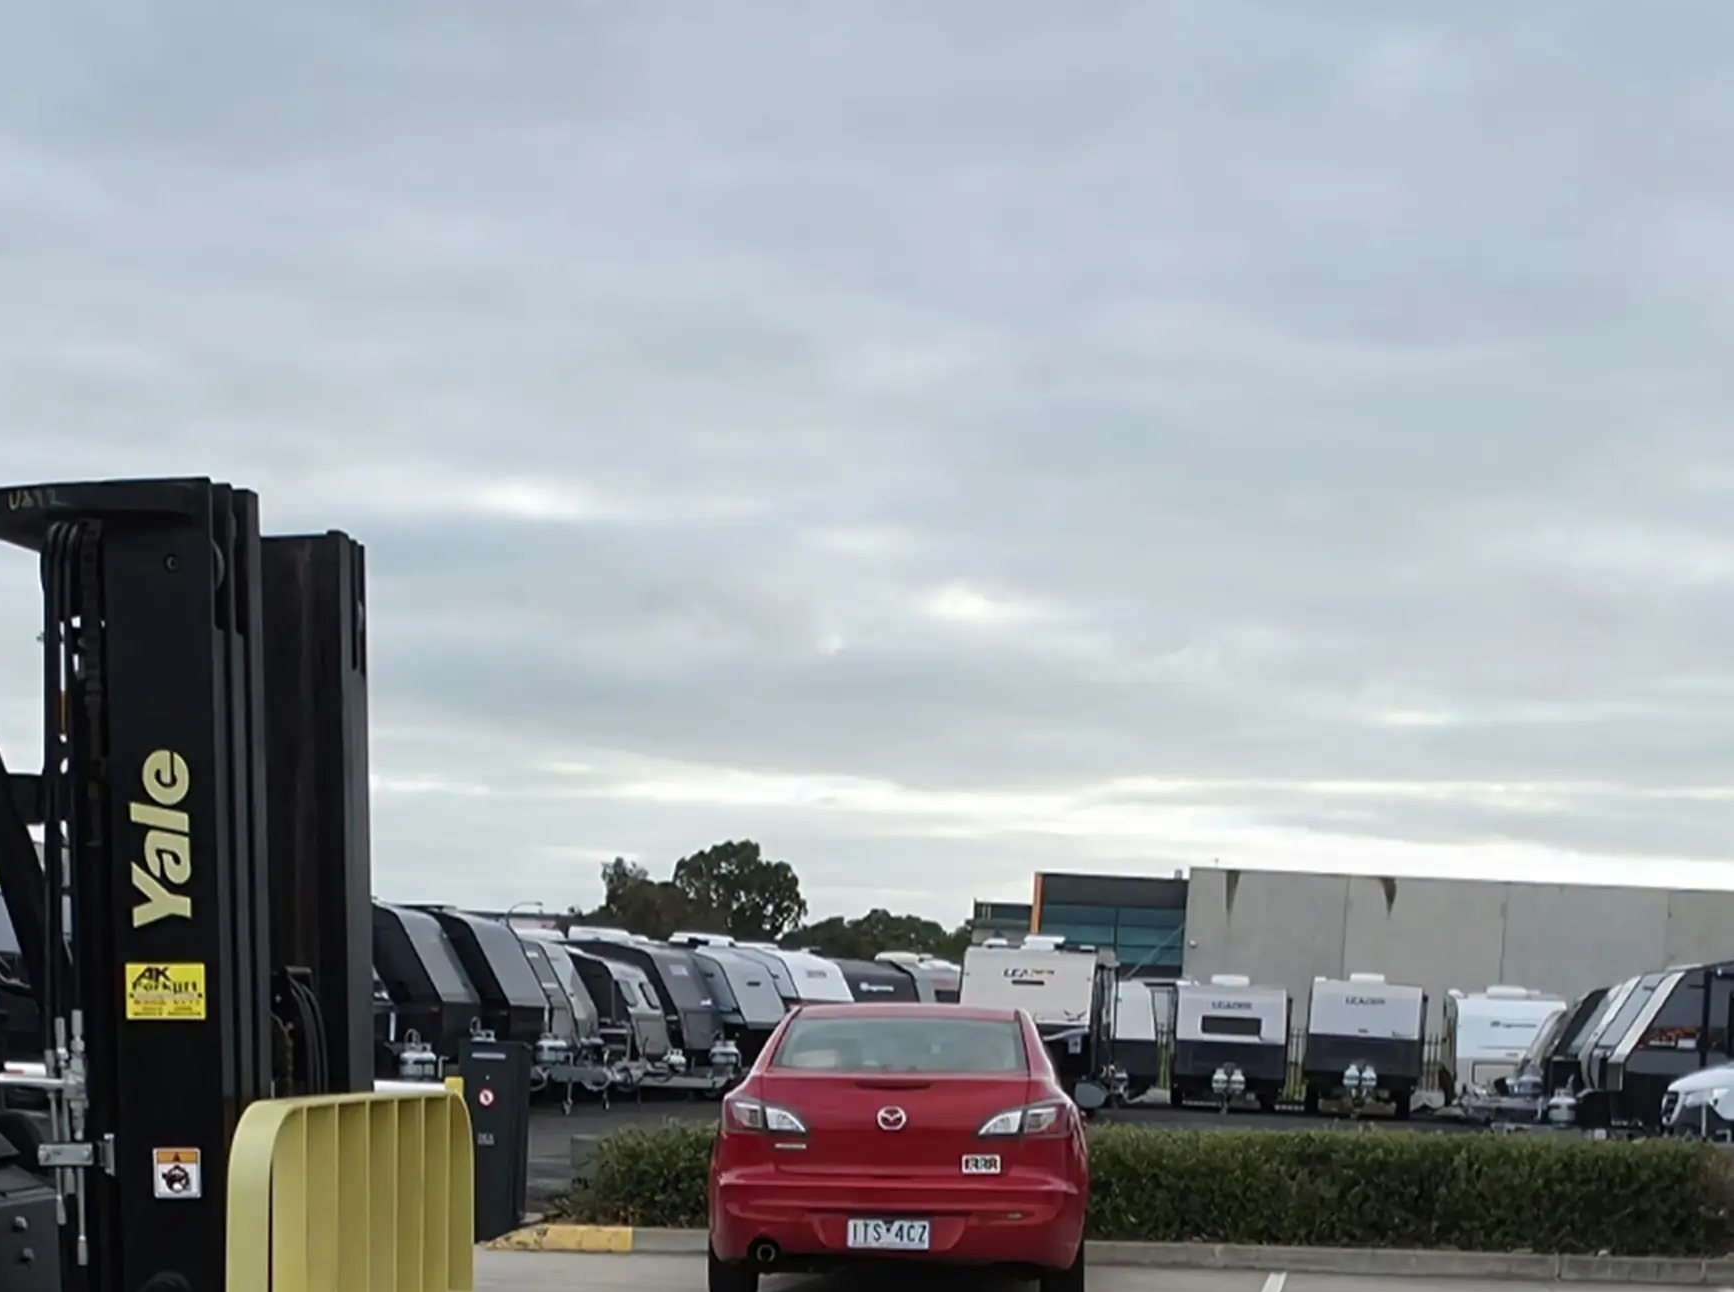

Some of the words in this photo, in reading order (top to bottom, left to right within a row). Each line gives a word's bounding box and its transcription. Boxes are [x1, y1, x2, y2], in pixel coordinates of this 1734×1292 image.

[130, 749, 192, 928] Yale
[134, 967, 171, 982] AK
[1004, 968, 1054, 978] LEA
